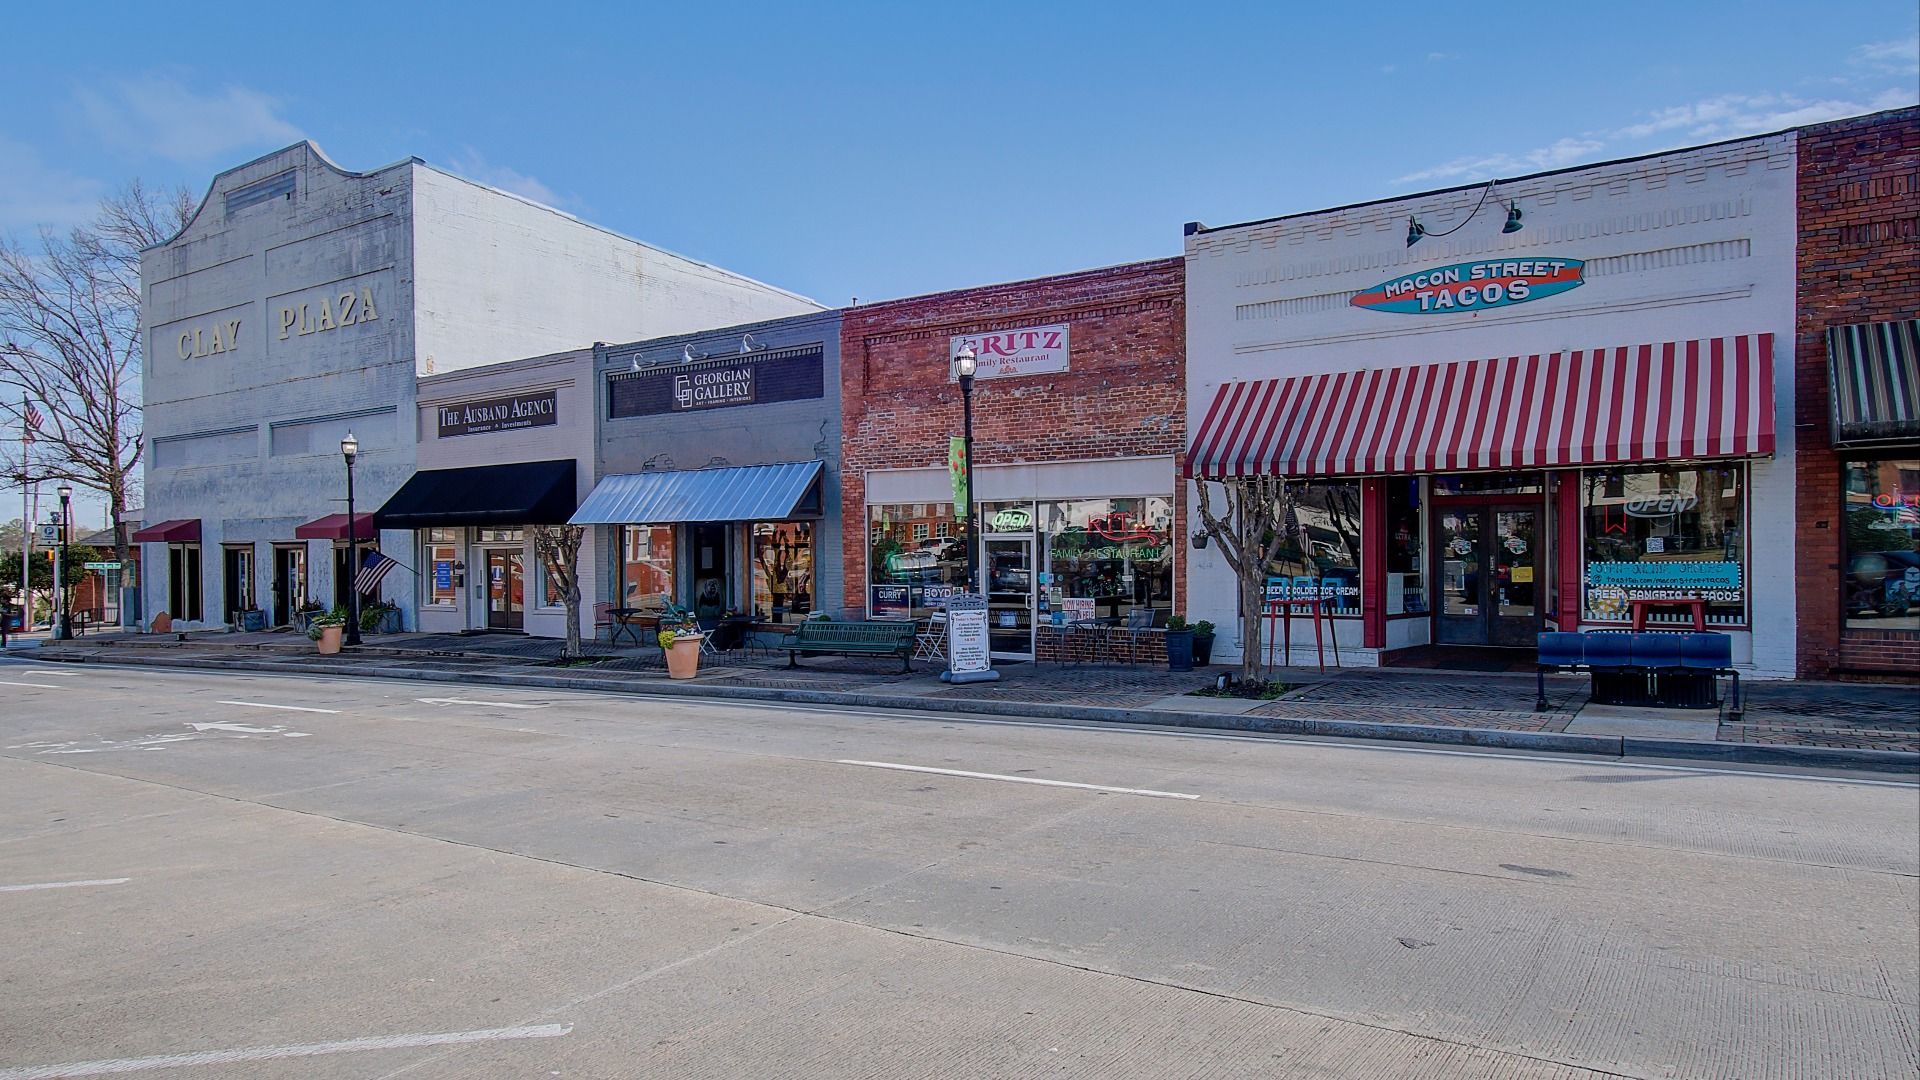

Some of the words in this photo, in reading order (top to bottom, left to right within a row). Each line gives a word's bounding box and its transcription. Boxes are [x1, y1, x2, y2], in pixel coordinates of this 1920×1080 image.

[1385, 268, 1459, 298] MACON
[1470, 261, 1566, 280] STREET
[1415, 280, 1530, 312] TACOS
[178, 319, 241, 360] CLAY
[279, 286, 379, 340] PLAZA
[975, 358, 998, 368] mily
[1000, 353, 1050, 365] Restaurant
[694, 368, 751, 386] GEORGIAN
[694, 381, 751, 400] GALLERY
[440, 407, 460, 426] THE
[463, 404, 508, 424] AUSBAND
[511, 398, 555, 418] AGENCY
[467, 425, 492, 433] Insurance
[501, 420, 532, 429] Investments
[1628, 494, 1689, 513] OPEN
[994, 512, 1028, 528] OPEN
[1050, 548, 1084, 559] FAMILY
[1089, 548, 1160, 559] RESTAURANT
[878, 590, 902, 600] CURRY
[924, 588, 951, 598] BOYD
[1266, 586, 1284, 595] BEER
[1292, 586, 1318, 595] COLDER
[1320, 586, 1334, 595] ICE
[1335, 587, 1359, 596] CREAM
[1588, 589, 1625, 599] FRESH
[1700, 590, 1741, 601] TACOS
[1062, 599, 1075, 609] NOW
[1076, 599, 1094, 610] HIRING
[1082, 610, 1095, 620] HELP
